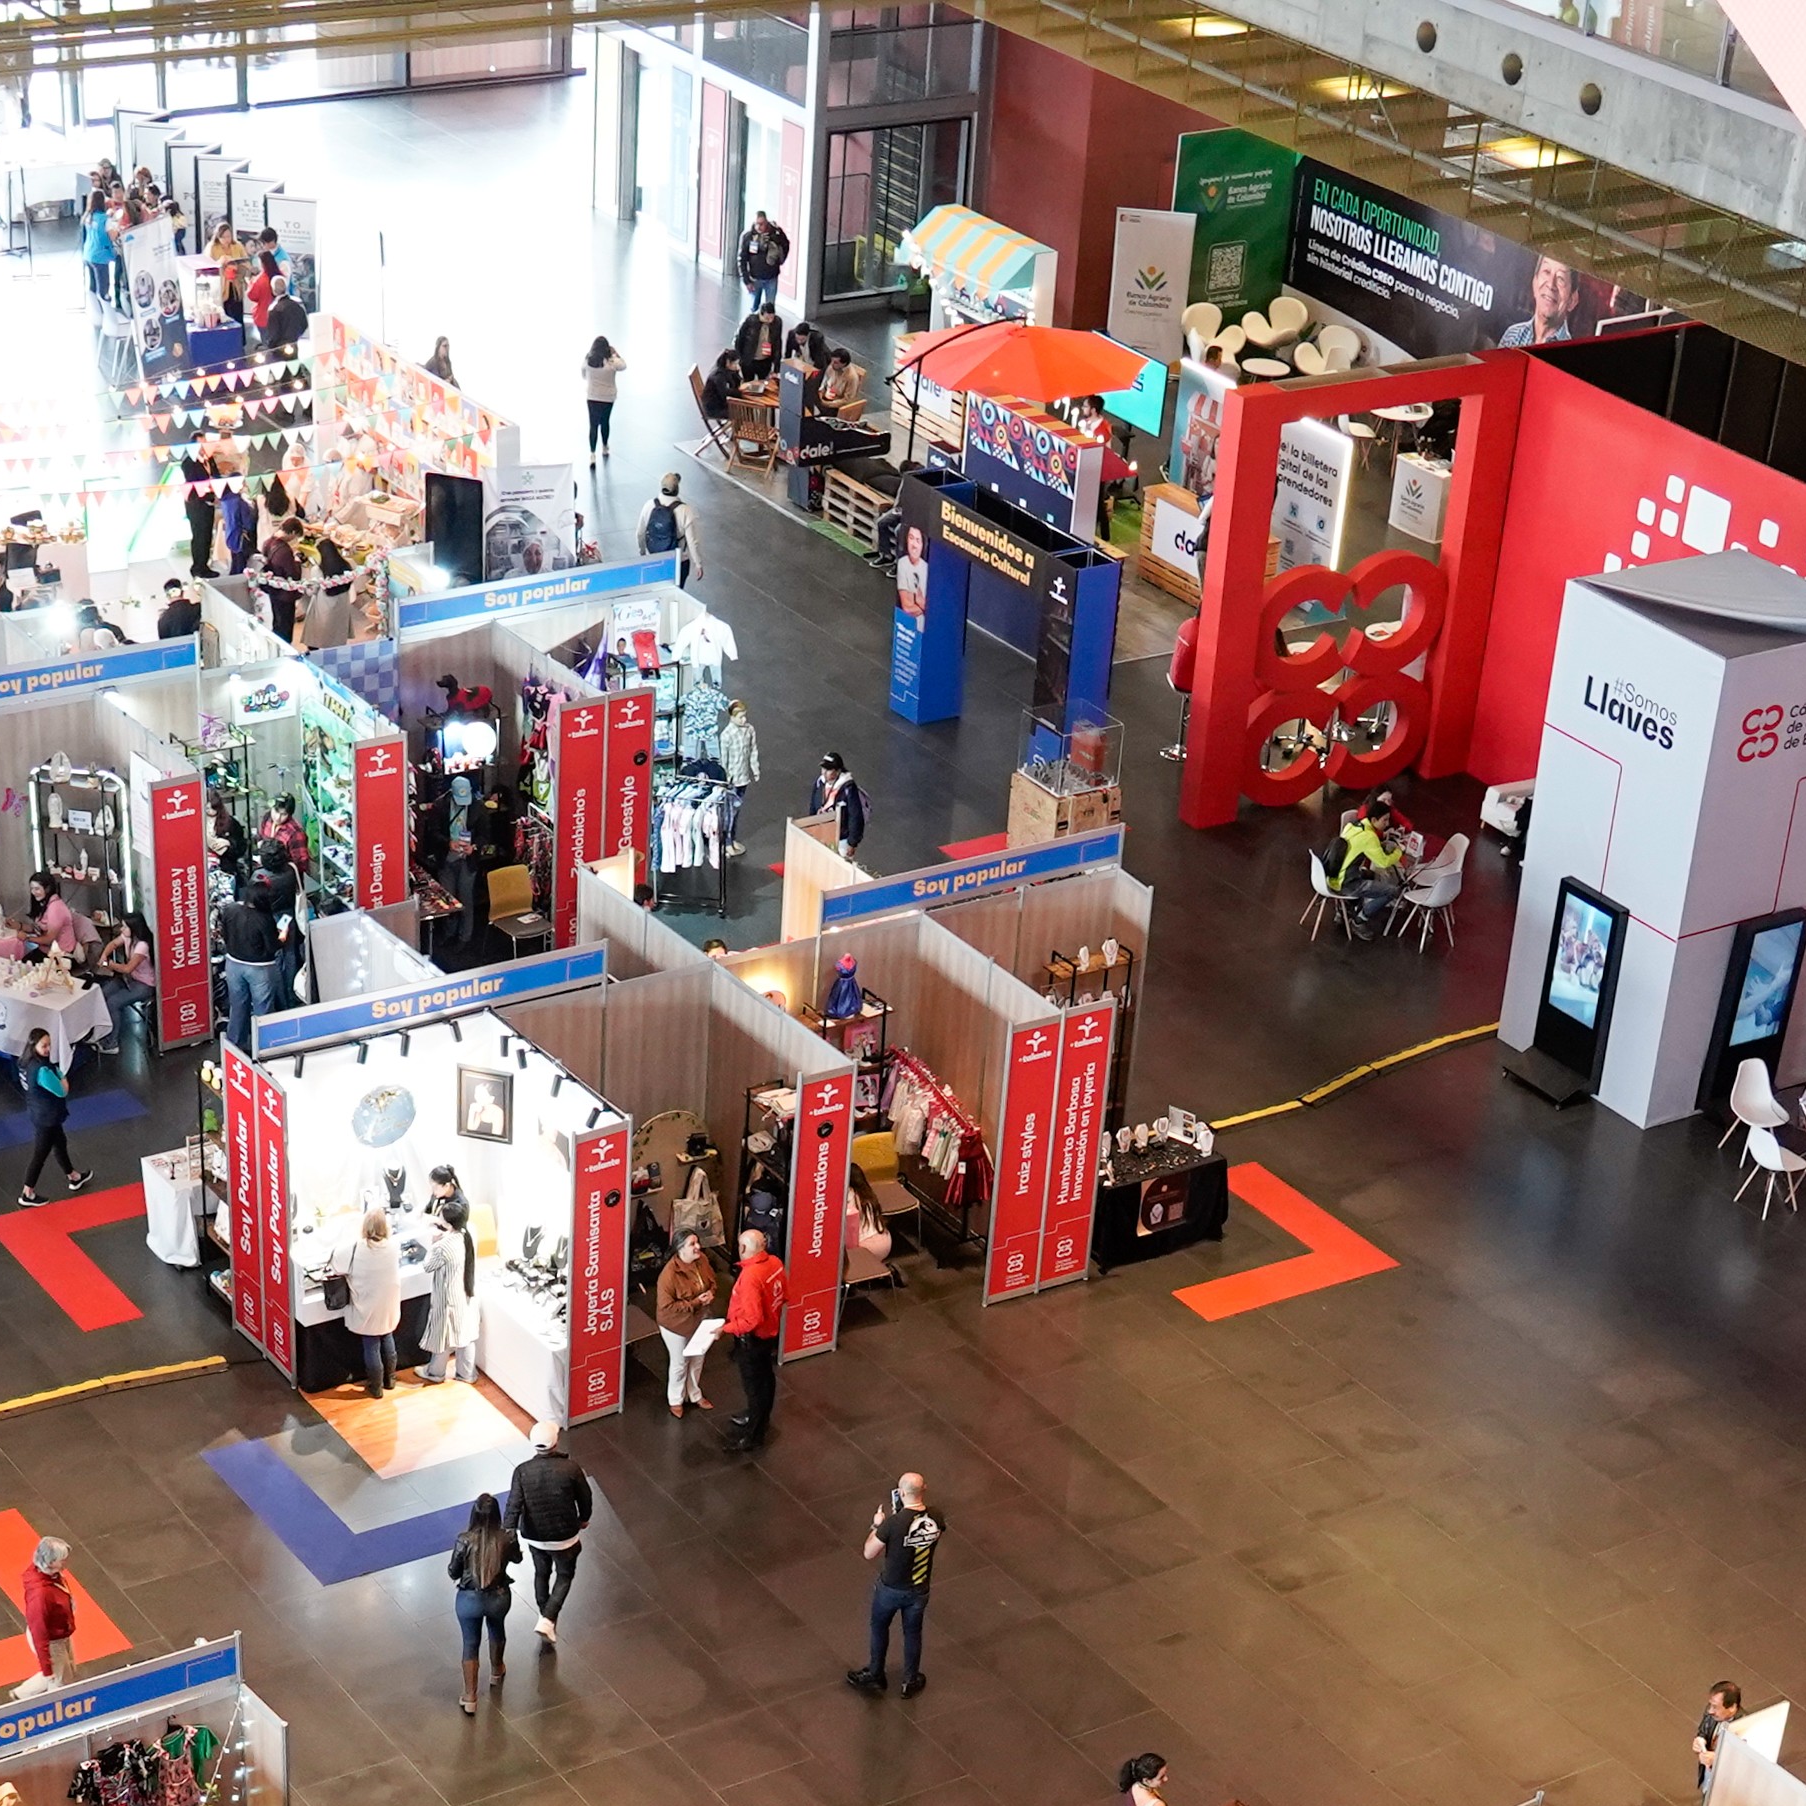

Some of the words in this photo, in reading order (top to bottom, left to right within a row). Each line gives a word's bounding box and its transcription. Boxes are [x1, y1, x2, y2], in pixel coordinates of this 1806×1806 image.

[1314, 178, 1329, 204] EN
[1331, 187, 1359, 217] CADA
[1362, 203, 1441, 257] OPORTUNIDAD,
[1306, 252, 1318, 267] sin
[1319, 257, 1352, 281] historial
[1310, 205, 1371, 252] NOSOTROS
[1373, 234, 1436, 286] LLEGAMOS
[1439, 265, 1494, 312] CONTIGO
[1301, 450, 1338, 477] billetera
[941, 500, 1023, 562] Bienvenidos
[943, 525, 989, 563] Escenario
[990, 553, 1031, 587] Cultural
[485, 592, 518, 608] Soy
[522, 577, 590, 605] popular
[27, 662, 104, 692] popular
[1613, 676, 1678, 726] #Somos
[1583, 674, 1675, 751] Llaves
[1786, 720, 1803, 734] de
[1783, 736, 1800, 750] de
[914, 876, 950, 897] Soy
[953, 858, 1026, 892] popular
[171, 887, 185, 939] Eventos
[186, 866, 200, 965] Manualidades
[173, 942, 185, 970] Kalu
[371, 999, 413, 1020] Soy
[419, 976, 503, 1010] popular
[1064, 1077, 1080, 1135] Barbosa
[1070, 1129, 1088, 1201] Innovación
[1079, 1062, 1096, 1106] joyería
[1017, 1112, 1036, 1158] styles
[237, 1112, 252, 1210] Popular
[1015, 1160, 1031, 1196] Iraiz
[1056, 1137, 1074, 1206] Humberto
[808, 1142, 830, 1258] Jeanspirations
[239, 1211, 252, 1256] Soy
[600, 1288, 614, 1342] S.A.S
